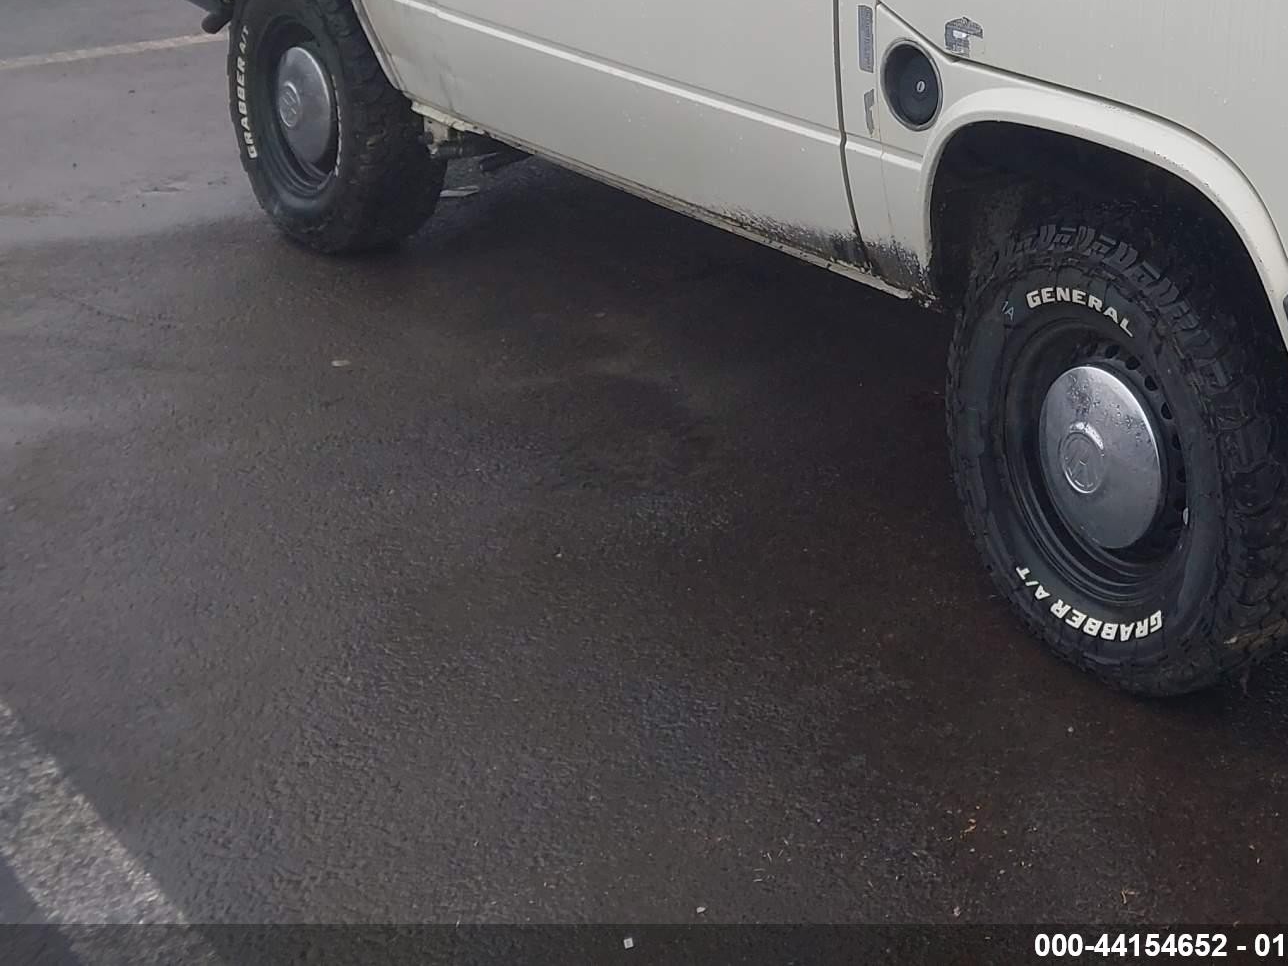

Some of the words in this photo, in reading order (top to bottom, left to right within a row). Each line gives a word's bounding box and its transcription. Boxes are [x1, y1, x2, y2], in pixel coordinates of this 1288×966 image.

[238, 24, 249, 55] A/T
[235, 56, 258, 160] GRABBER
[1025, 286, 1134, 338] GENERAL
[1015, 566, 1051, 601] A/T
[1050, 598, 1164, 642] GRABBER
